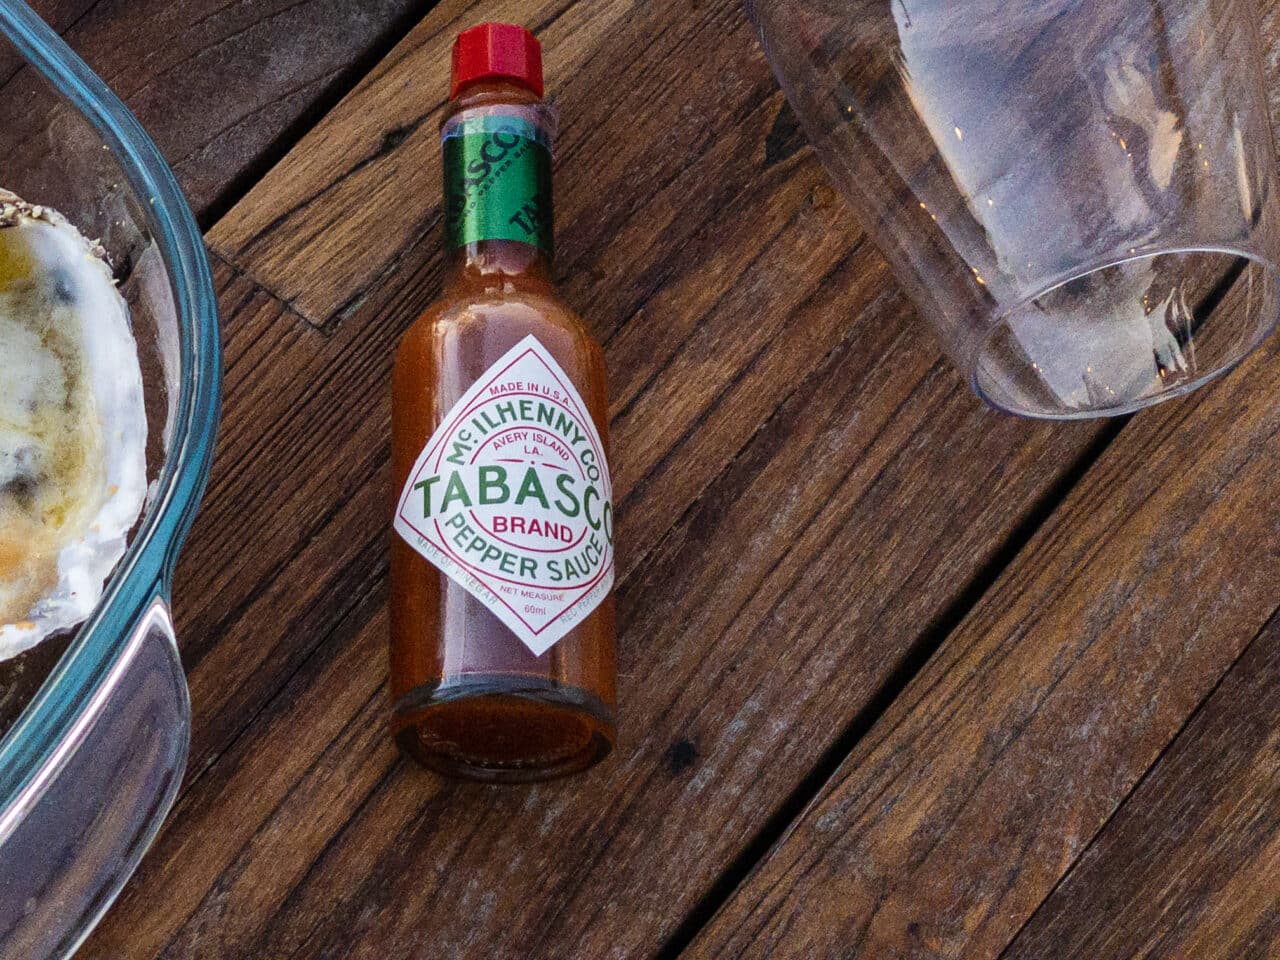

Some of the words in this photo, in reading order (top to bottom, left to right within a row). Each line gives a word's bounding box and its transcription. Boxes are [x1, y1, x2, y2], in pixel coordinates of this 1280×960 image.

[489, 381, 524, 396] MADE
[527, 382, 539, 392] IN
[493, 431, 529, 451] AVERY
[532, 432, 570, 461] ISLAND
[492, 516, 573, 543] BRAND
[445, 512, 538, 580] PEPPER
[547, 531, 604, 582] SAUCE
[499, 584, 519, 595] NET
[520, 590, 565, 602] MEASURE
[524, 604, 547, 616] 60ml
